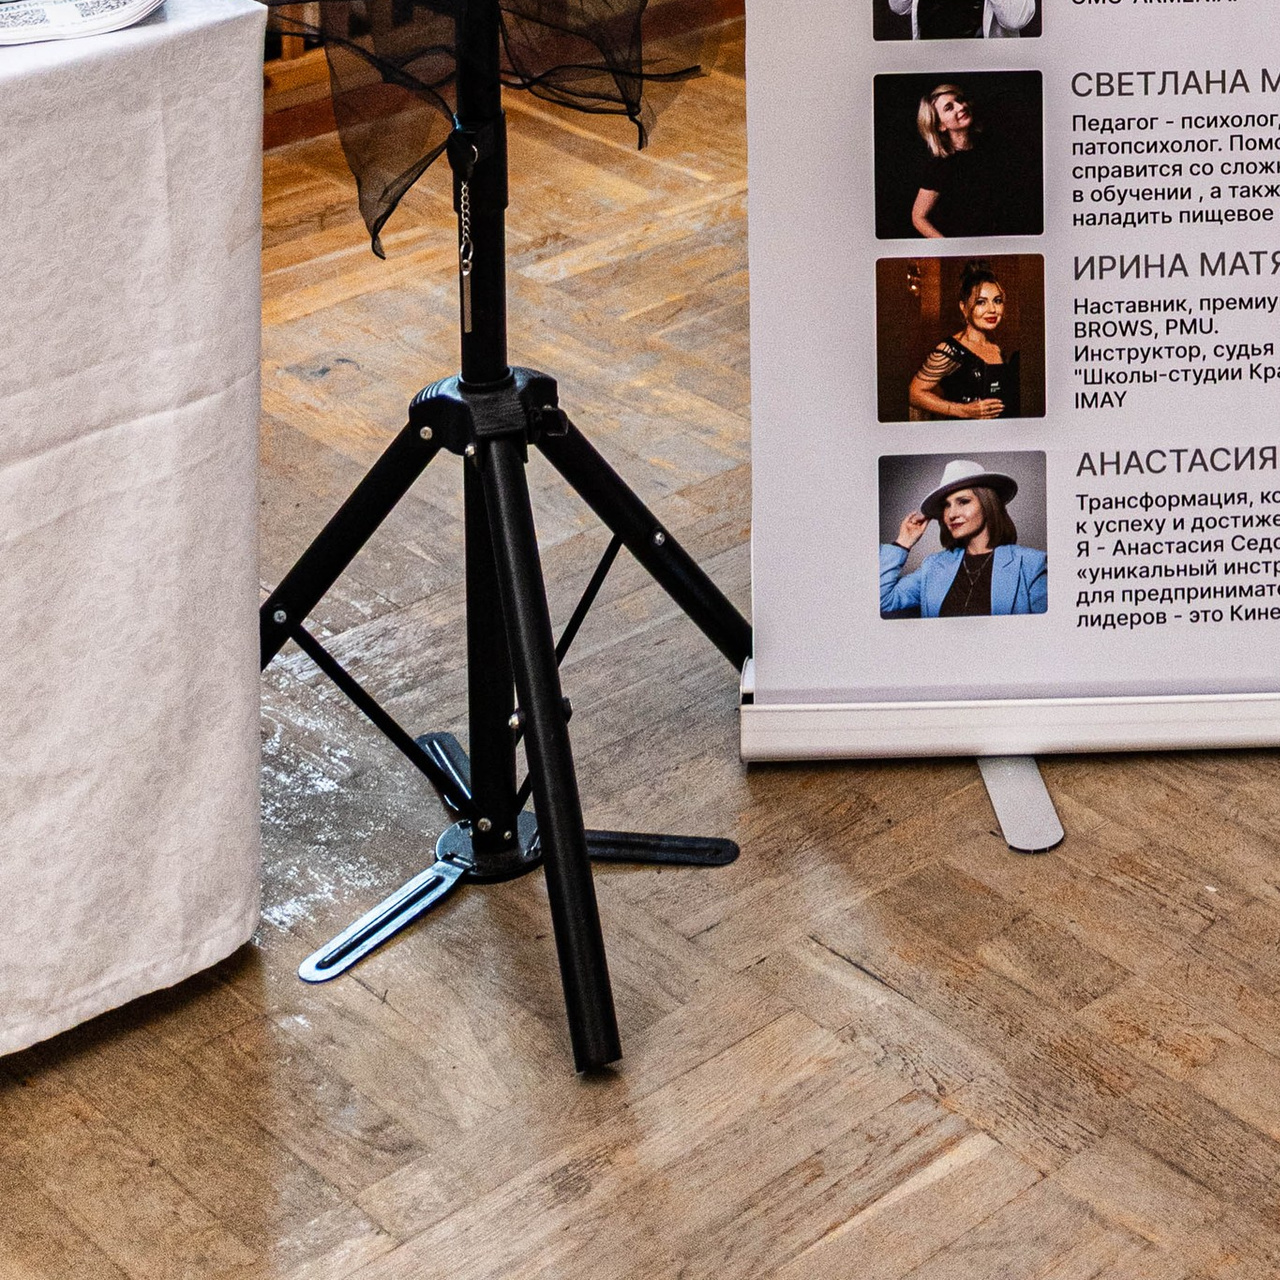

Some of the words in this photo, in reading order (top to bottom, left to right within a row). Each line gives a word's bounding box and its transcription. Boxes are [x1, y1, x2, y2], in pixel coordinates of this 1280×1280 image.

[1070, 68, 1250, 98] СВЕТЛАНА
[1072, 114, 1159, 135] Педагог
[1072, 138, 1223, 156] патопсихолог.
[1071, 163, 1183, 183] справится
[1188, 162, 1214, 177] со
[1072, 189, 1085, 203] в
[1090, 184, 1192, 206] обучении
[1209, 185, 1222, 200] а
[1072, 211, 1173, 229] наладить
[1179, 207, 1274, 226] пищевое
[1073, 252, 1189, 281] ИРИНА
[1073, 297, 1193, 315] Наставник,
[1074, 319, 1159, 339] BROWS,
[1165, 317, 1219, 336] PMU.
[1074, 344, 1207, 365] Инструктор,
[1213, 342, 1274, 362] судья
[1074, 367, 1243, 387] "Школы-студии
[1074, 390, 1127, 410] IMAY
[1075, 445, 1277, 478] АНАСТАСИЯ
[1075, 491, 1254, 515] Трансформация,
[1075, 520, 1088, 535] к
[1093, 518, 1167, 538] успеху
[1172, 517, 1185, 531] и
[1076, 540, 1090, 558] Я
[1112, 539, 1224, 557] Анастасия
[1076, 559, 1217, 585] «уникальный
[1075, 589, 1115, 608] для
[1076, 611, 1168, 630] лидеров
[1189, 608, 1224, 624] это
